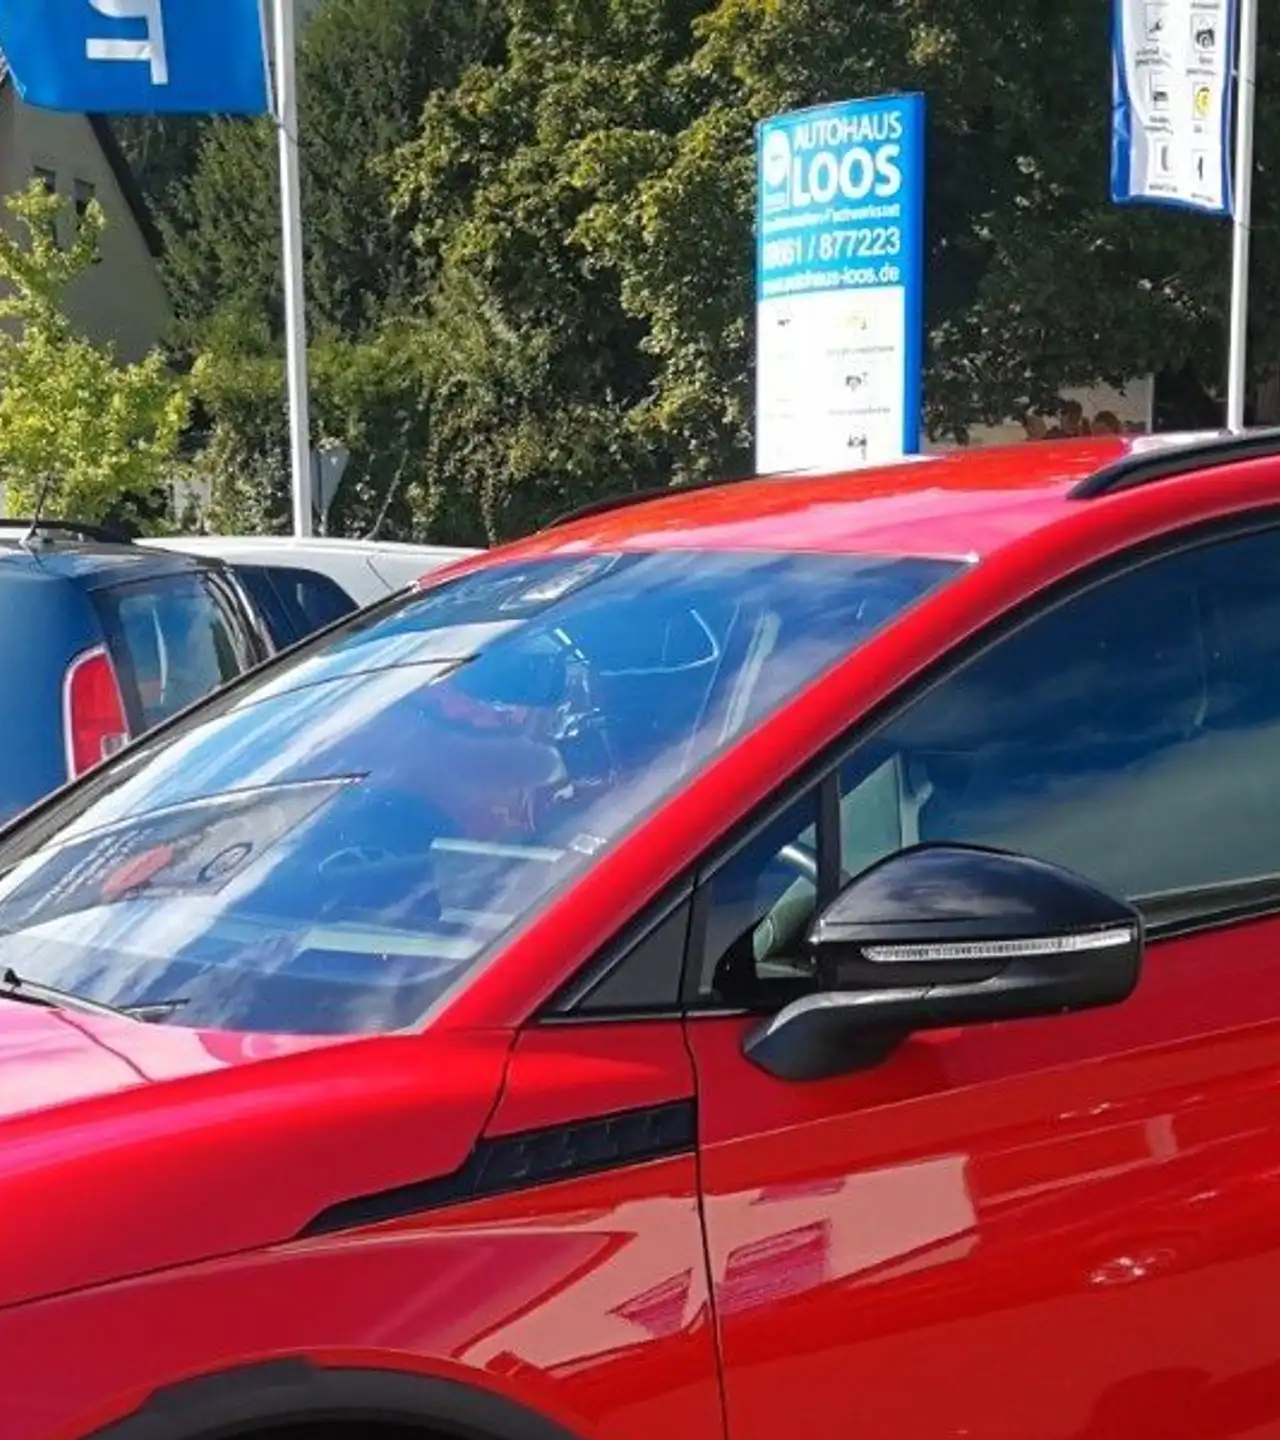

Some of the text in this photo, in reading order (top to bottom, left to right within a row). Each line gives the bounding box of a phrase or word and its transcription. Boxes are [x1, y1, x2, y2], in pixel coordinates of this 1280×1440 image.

[793, 110, 902, 150] AUTOHAUS
[791, 144, 902, 207] LOOS
[819, 226, 901, 261] 877223
